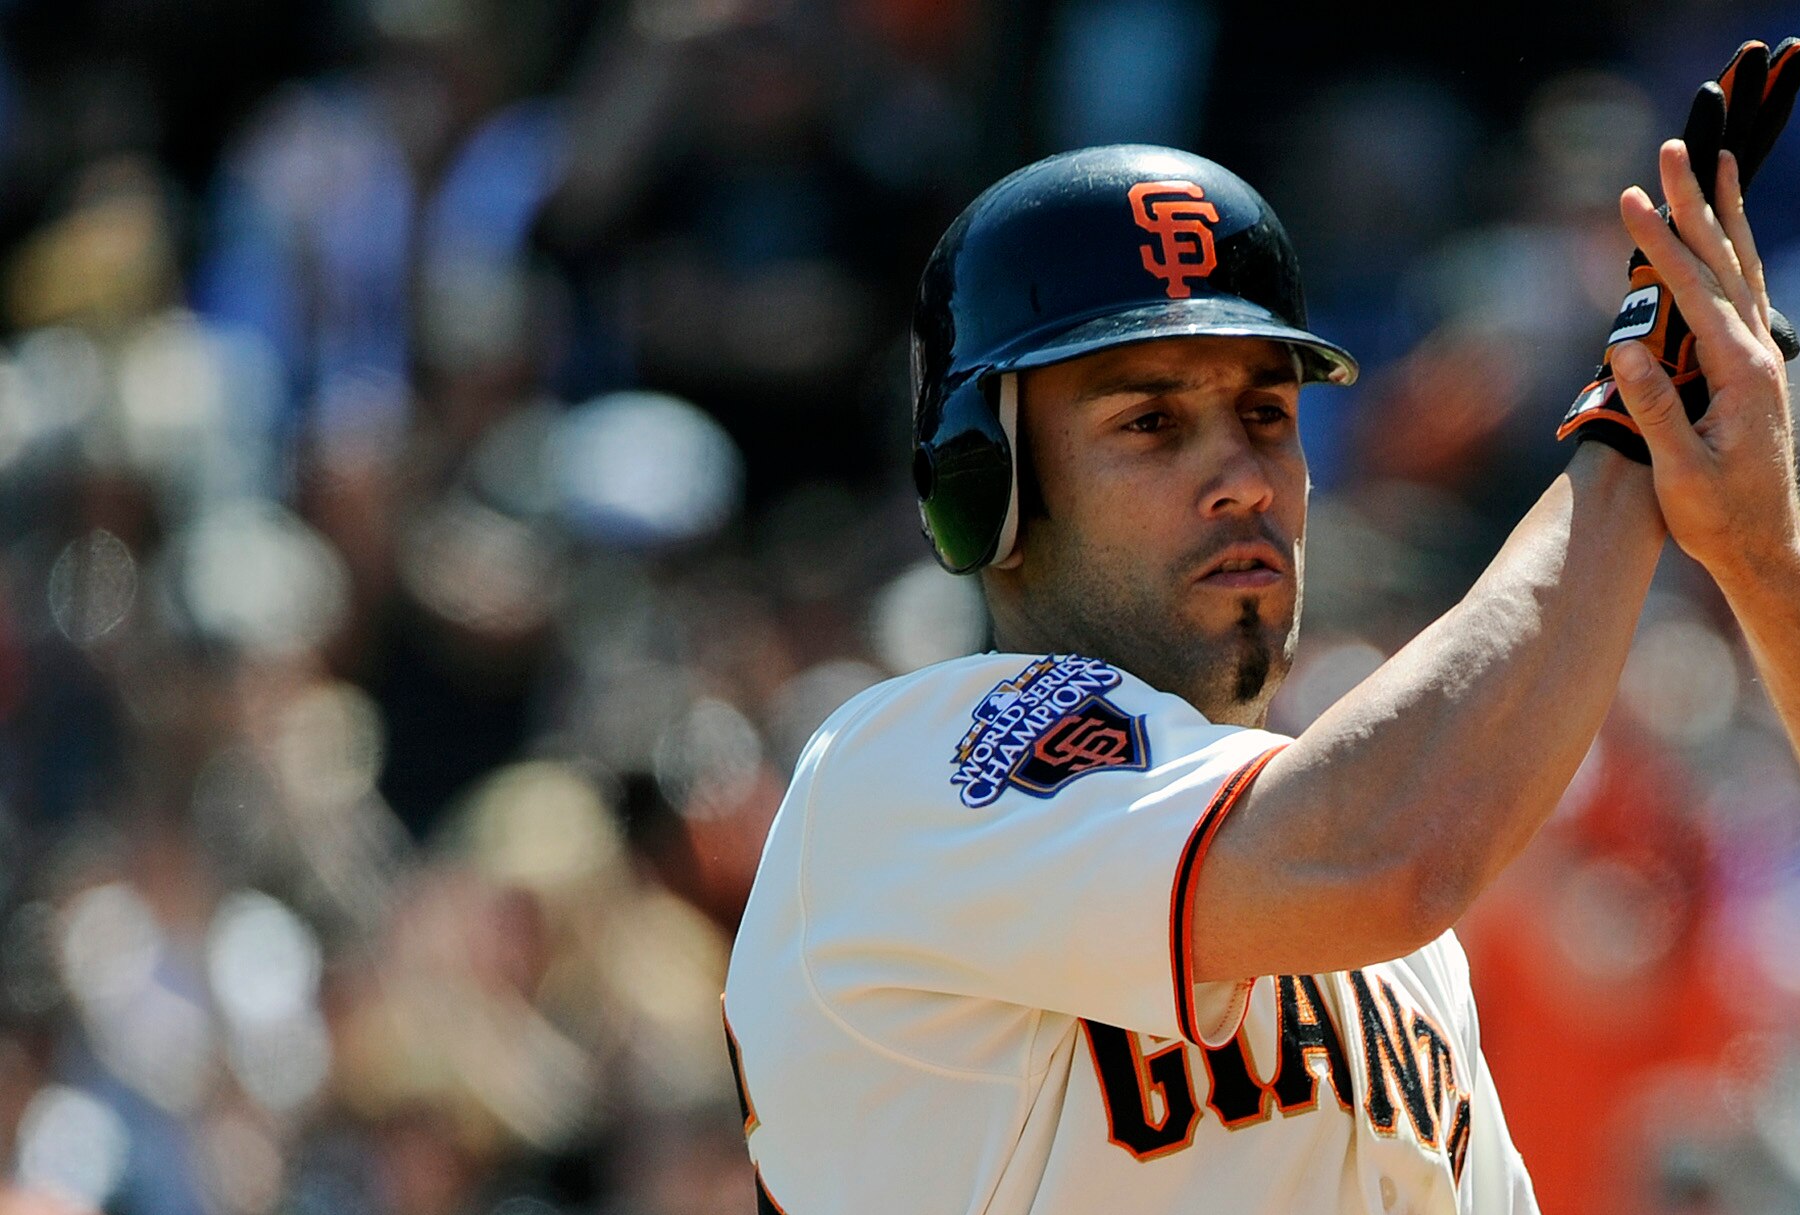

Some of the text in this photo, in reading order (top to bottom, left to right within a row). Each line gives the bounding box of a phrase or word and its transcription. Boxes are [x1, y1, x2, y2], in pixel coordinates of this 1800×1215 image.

[1128, 180, 1219, 298] SF
[954, 654, 1089, 784] WORLD SERIES
[962, 659, 1120, 806] CHAMPIONS
